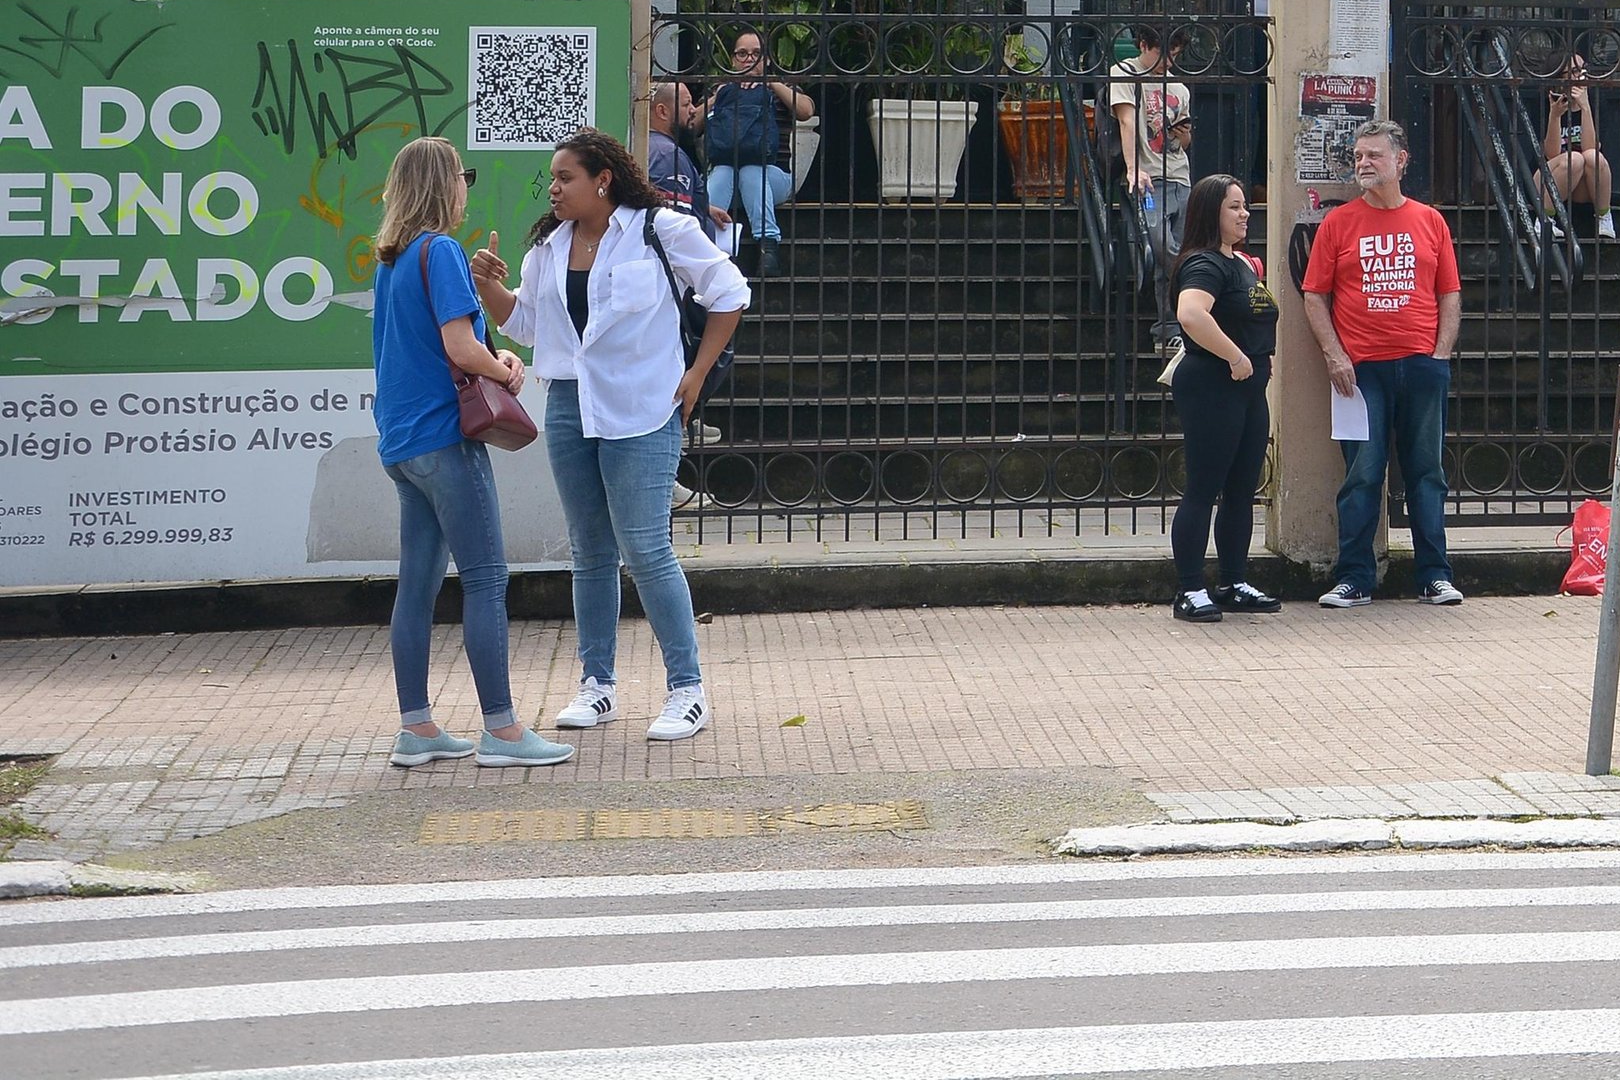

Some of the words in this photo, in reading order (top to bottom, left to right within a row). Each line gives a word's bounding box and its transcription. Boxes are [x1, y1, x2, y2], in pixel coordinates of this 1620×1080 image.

[314, 26, 353, 36] Aponte
[364, 26, 402, 35] câmera
[405, 26, 419, 35] do
[313, 38, 348, 47] celular
[351, 39, 375, 48] para
[406, 38, 436, 47] Code.
[81, 85, 221, 150] DO
[1359, 234, 1394, 258] EU
[1397, 233, 1412, 243] FA
[1360, 255, 1416, 272] VALER
[1362, 274, 1371, 283] A
[1373, 270, 1415, 282] MINHA
[1362, 279, 1415, 293] HISTÓRIA
[1, 393, 78, 422] ação
[90, 399, 108, 416] e
[118, 389, 299, 417] Construção
[310, 389, 348, 411] de
[104, 429, 237, 454] Protásio
[247, 428, 334, 450] Alves
[69, 489, 226, 507] INVESTIMENTO
[70, 511, 136, 527] TOTAL
[68, 531, 96, 548] R$
[102, 526, 234, 547] 6.299.999,83
